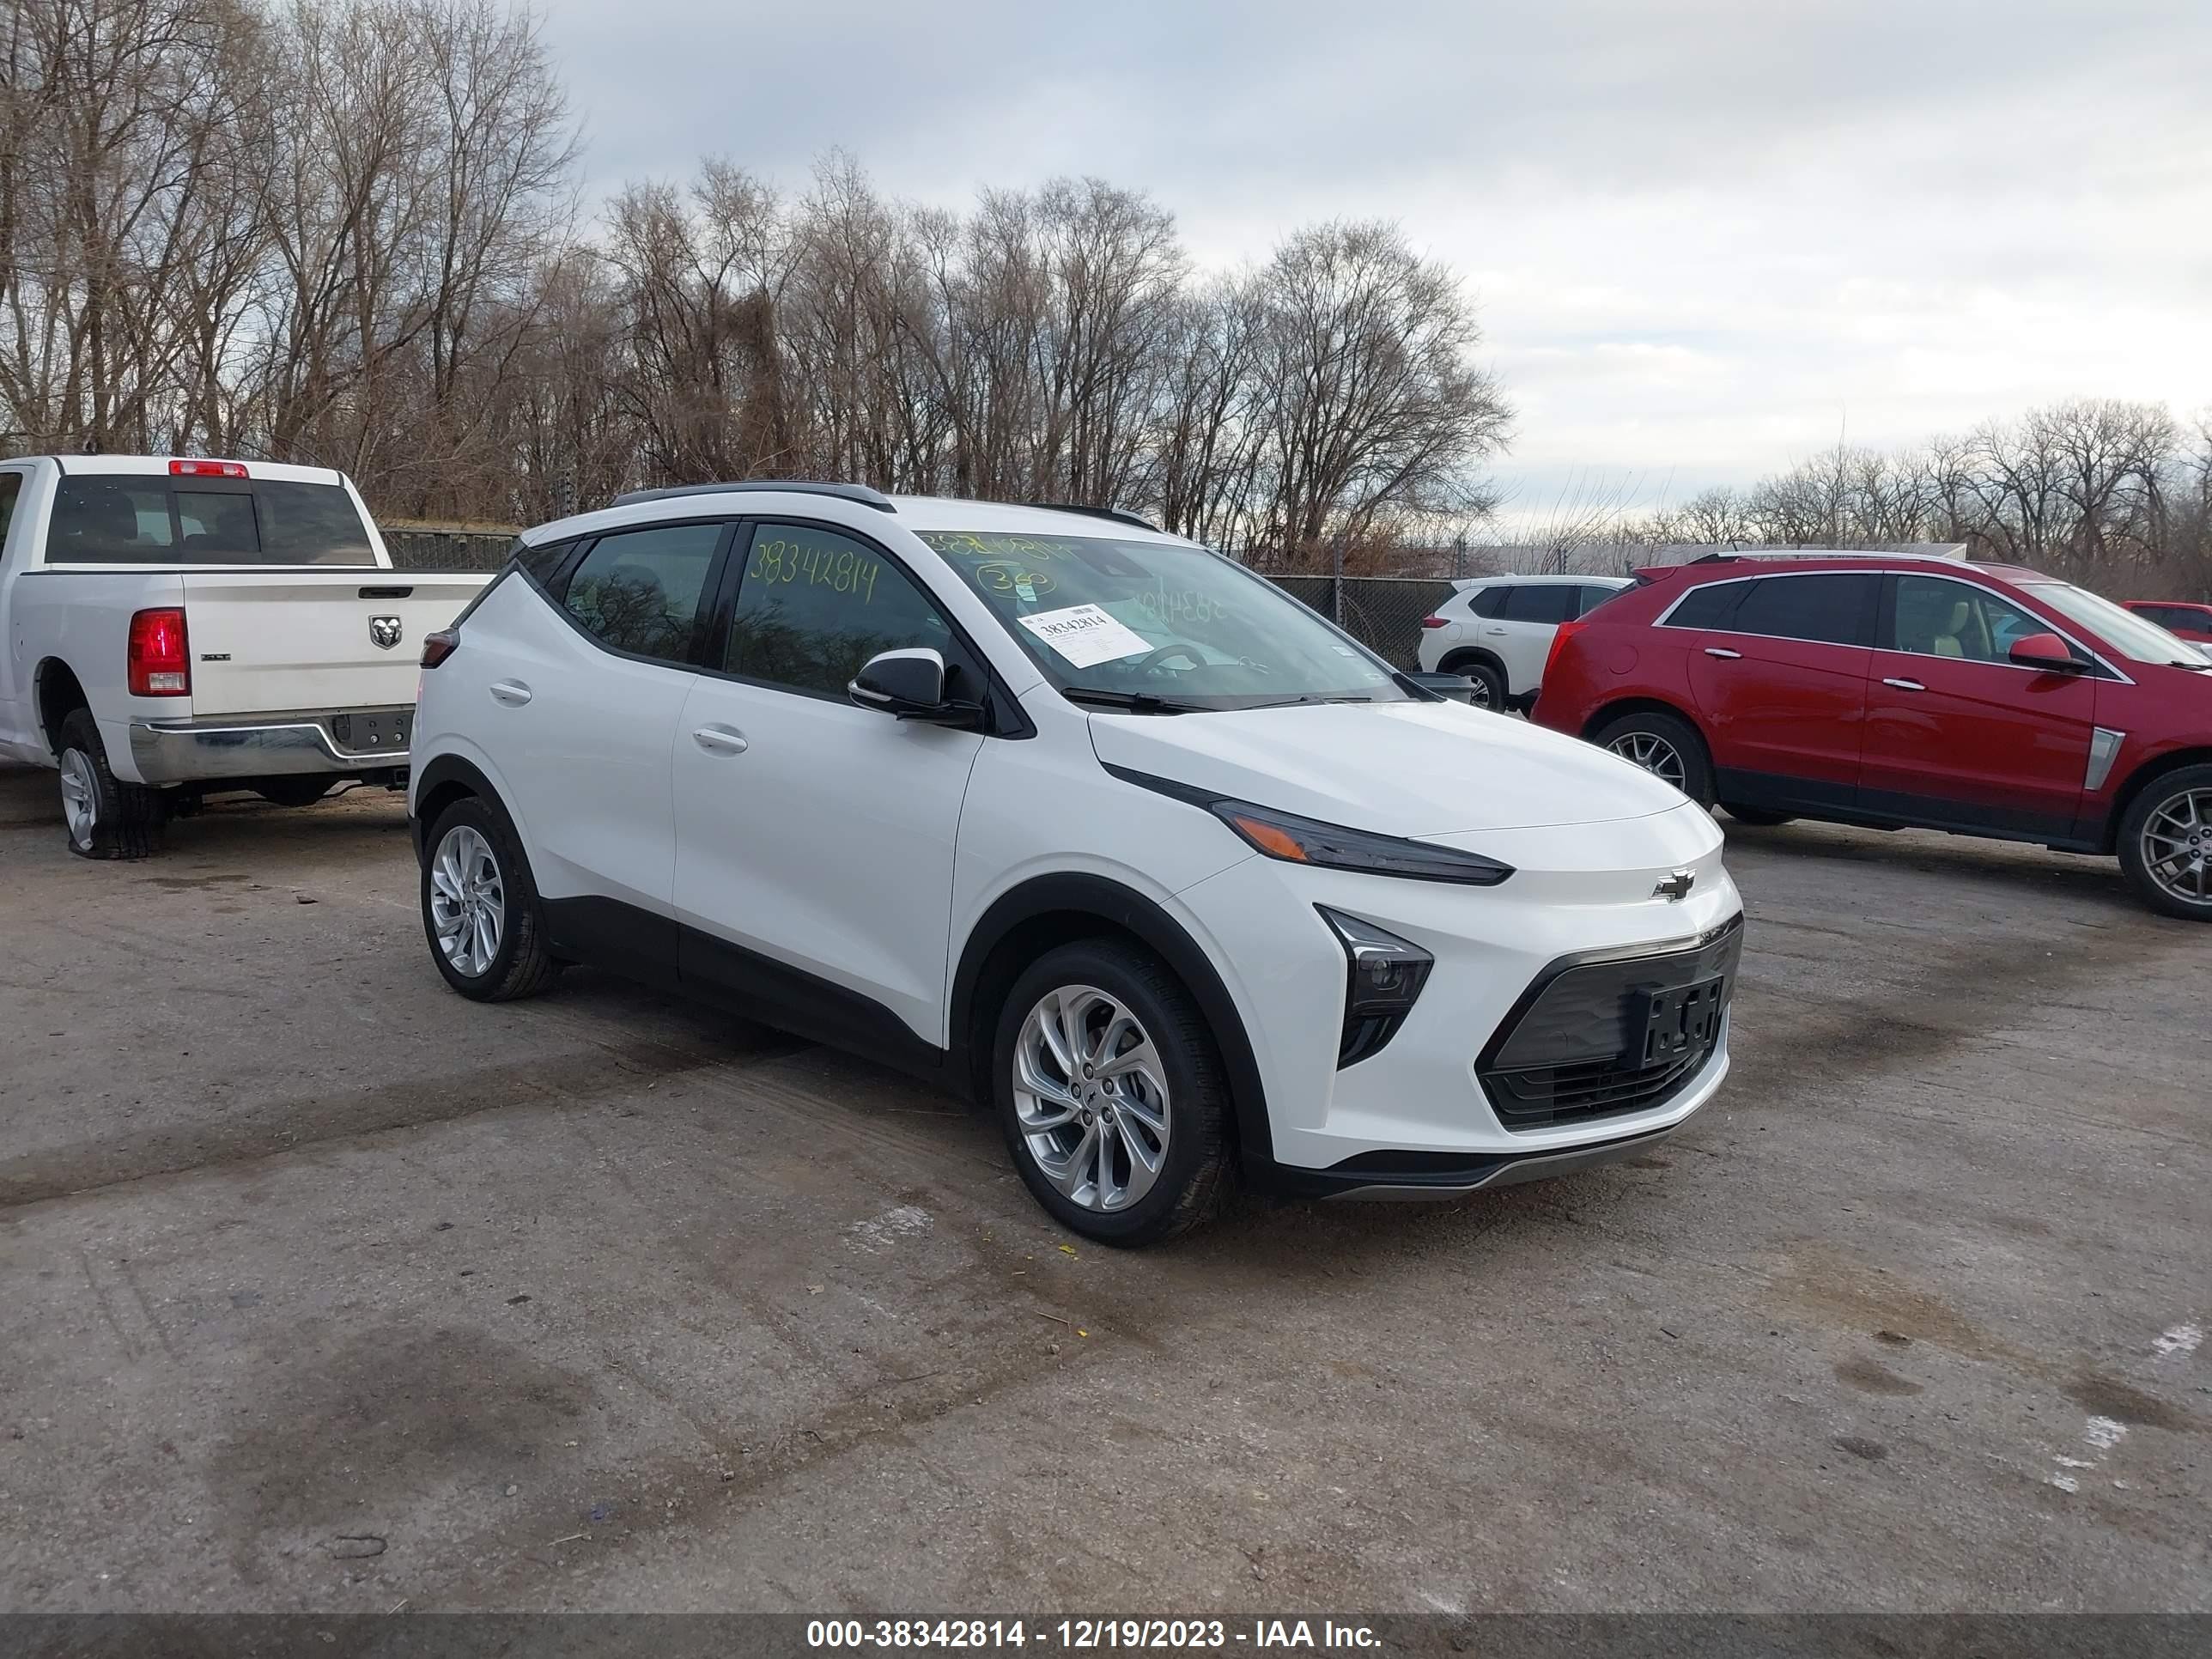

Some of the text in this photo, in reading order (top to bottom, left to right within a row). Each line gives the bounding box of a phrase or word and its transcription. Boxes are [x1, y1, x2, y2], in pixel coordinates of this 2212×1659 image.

[750, 540, 878, 605] 38342814
[985, 569, 1048, 590] 360
[1040, 614, 1108, 637] 38342814
